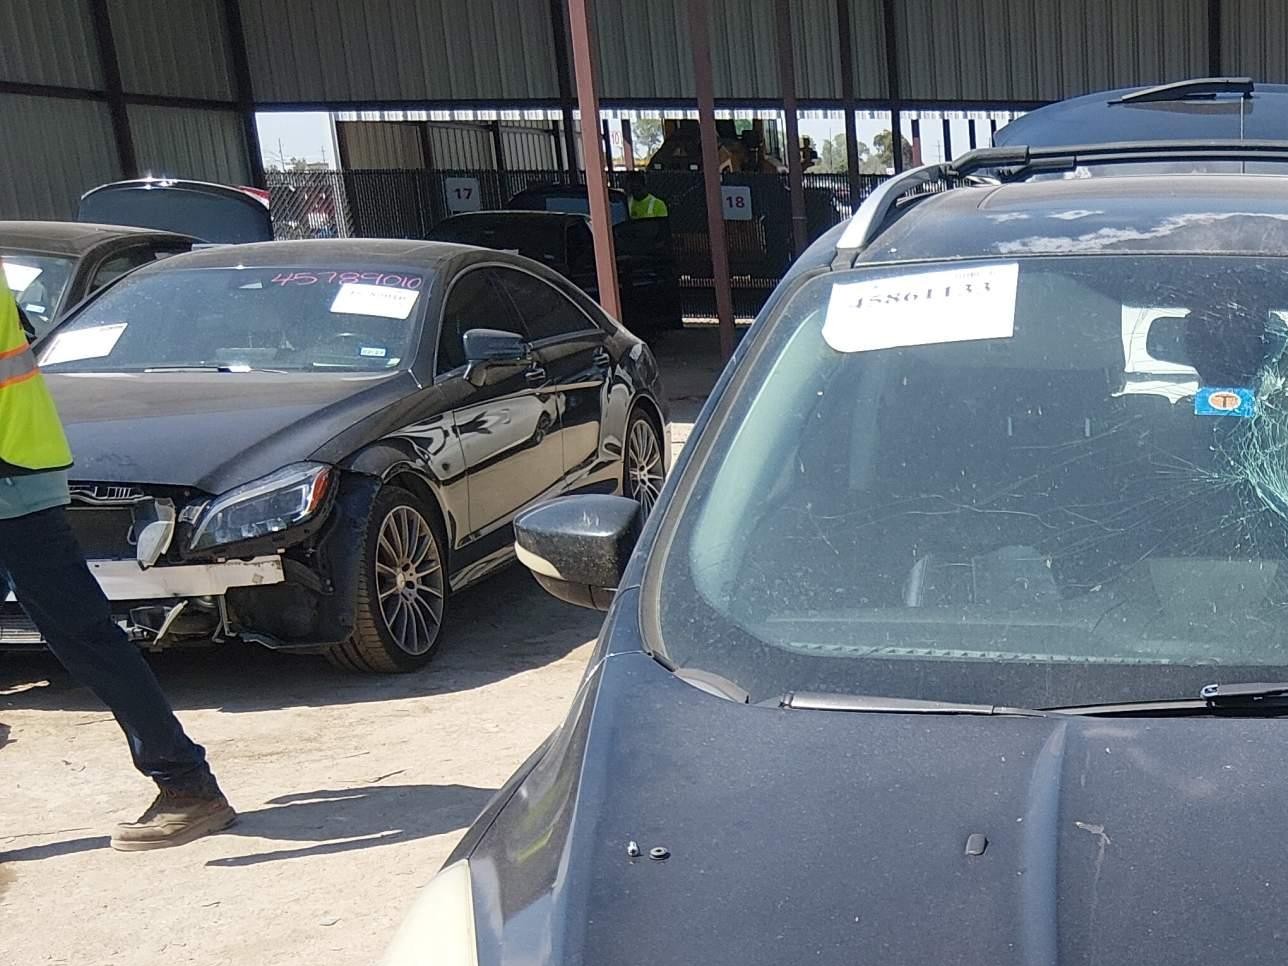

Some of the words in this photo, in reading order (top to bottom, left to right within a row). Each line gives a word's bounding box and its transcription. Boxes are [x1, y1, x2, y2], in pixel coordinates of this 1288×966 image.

[455, 187, 472, 200] 17
[726, 196, 745, 208] 18
[271, 271, 422, 289] 45789010
